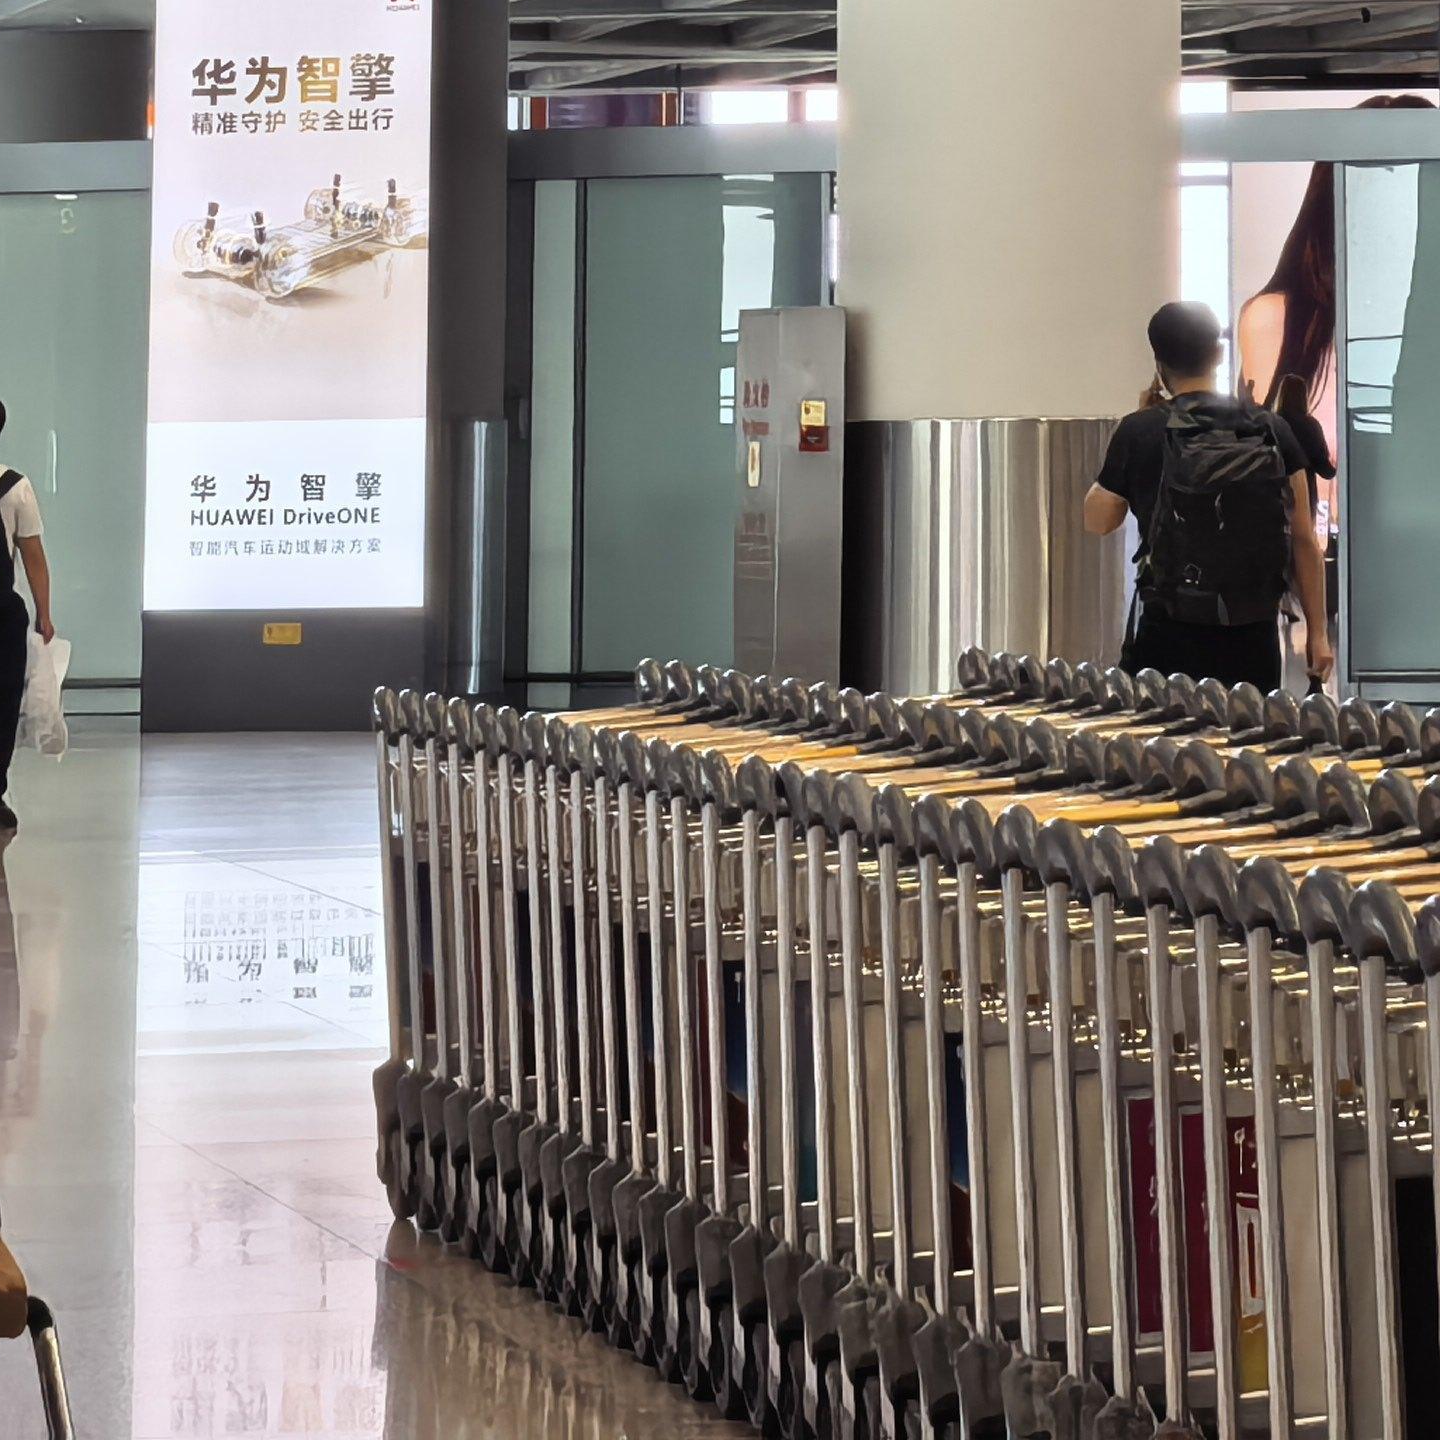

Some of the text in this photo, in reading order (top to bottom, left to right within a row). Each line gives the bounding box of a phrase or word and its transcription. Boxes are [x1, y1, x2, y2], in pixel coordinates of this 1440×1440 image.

[191, 52, 395, 106] 华为智擎
[191, 108, 395, 135] 精准守护 安全出行
[189, 472, 383, 503] 华为智擎
[190, 506, 381, 526] HUAWEI DriveONE
